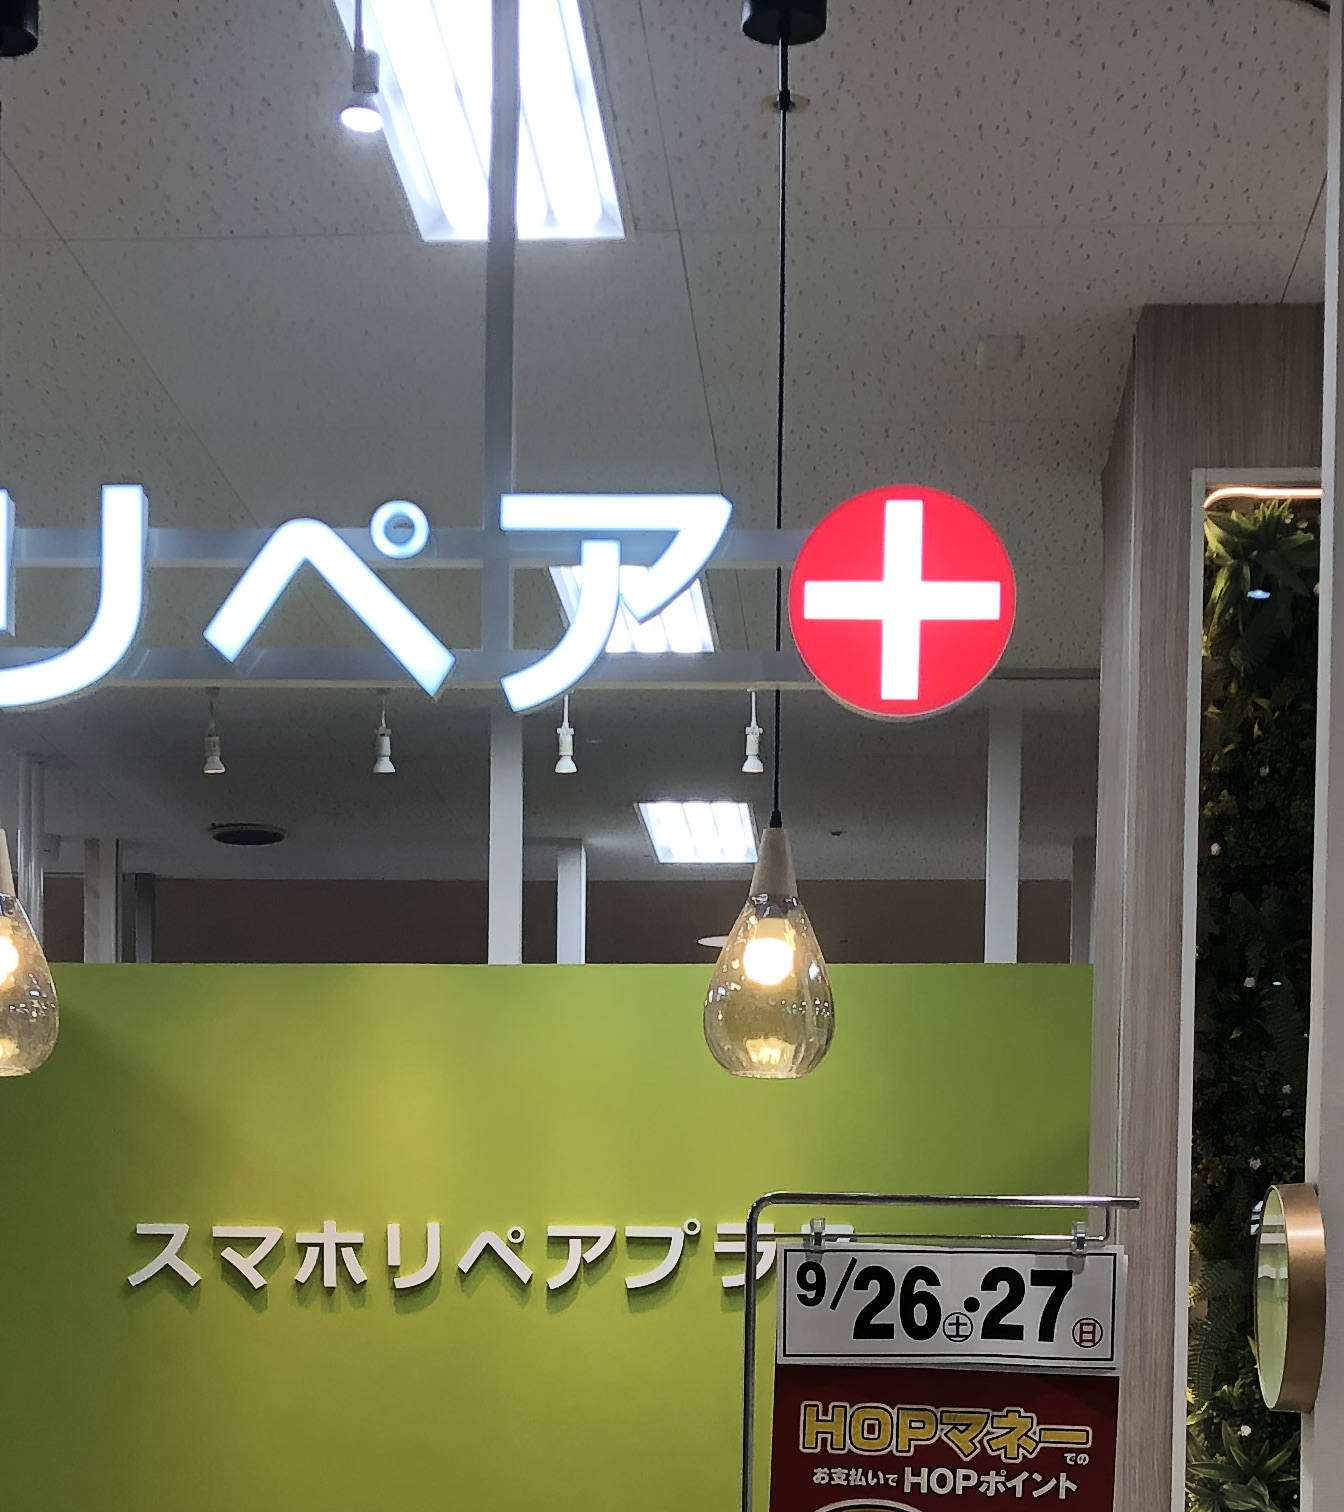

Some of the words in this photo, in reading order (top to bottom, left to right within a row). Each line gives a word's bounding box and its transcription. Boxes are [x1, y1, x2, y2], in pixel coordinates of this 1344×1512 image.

[127, 1217, 854, 1290] スマホリペアプラ
[799, 1402, 1092, 1461] HOPマネー
